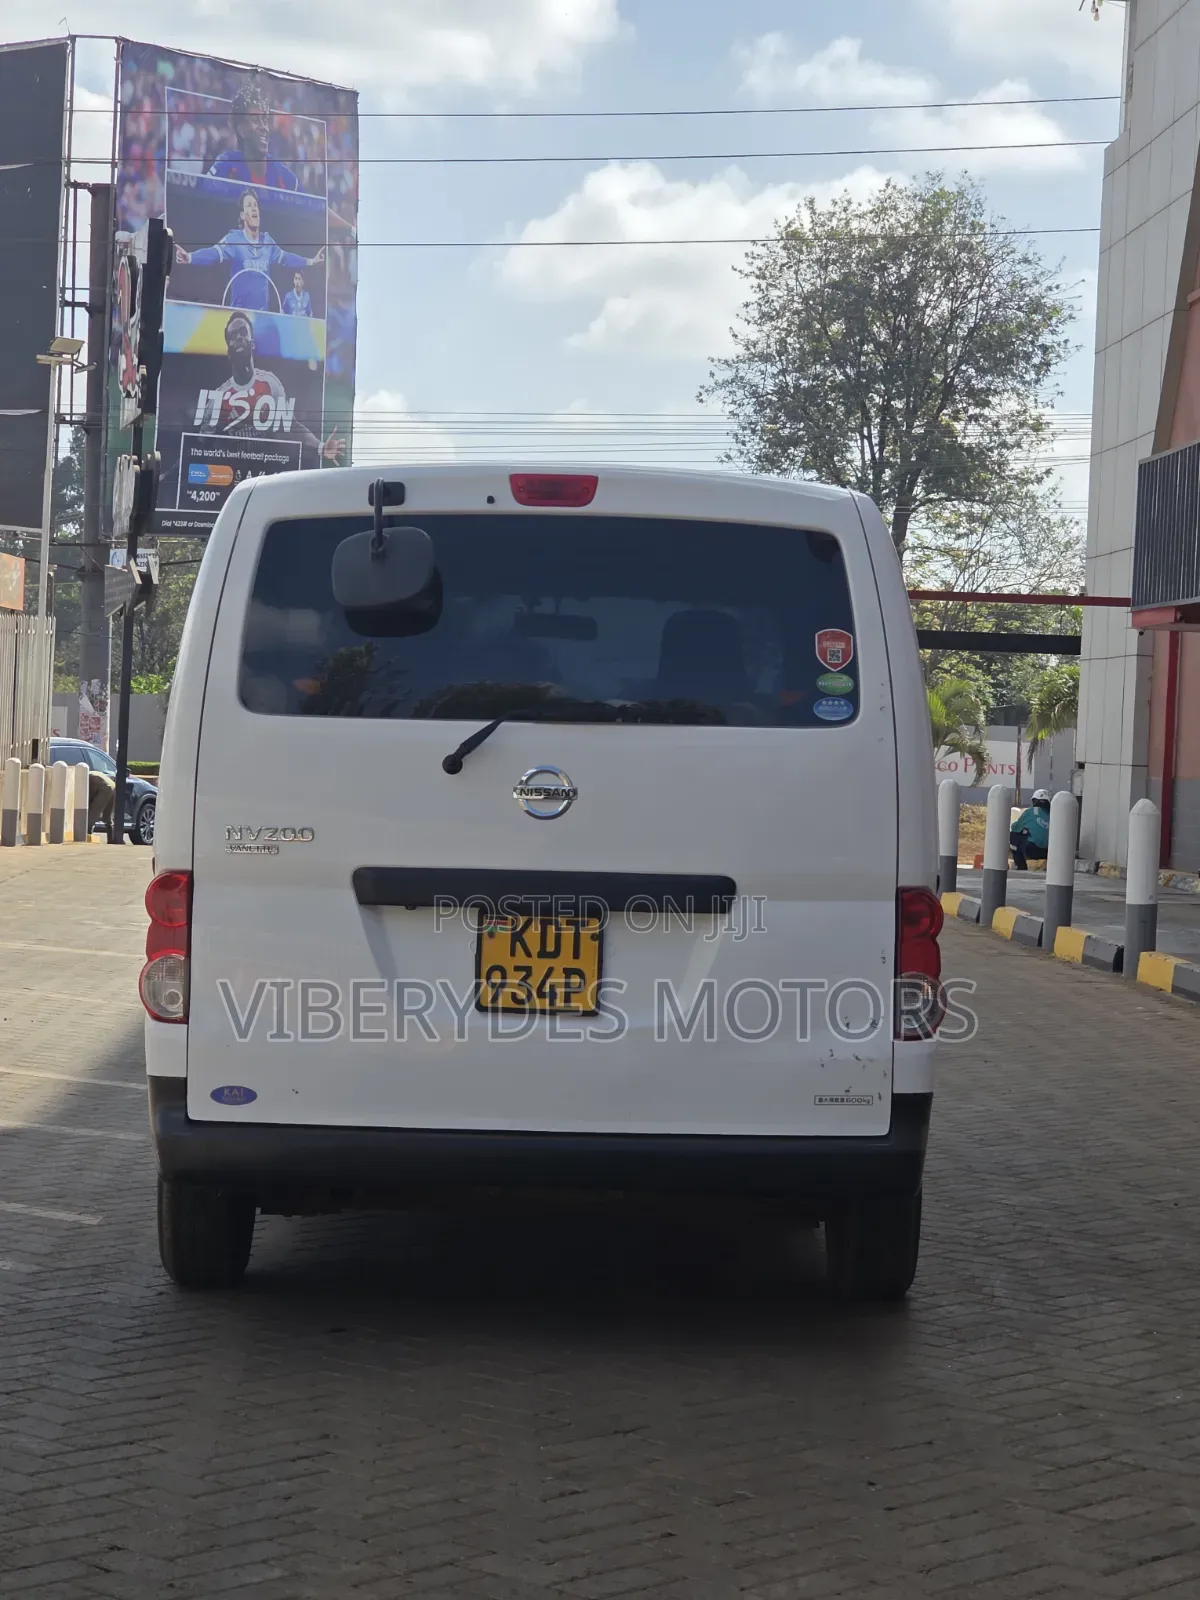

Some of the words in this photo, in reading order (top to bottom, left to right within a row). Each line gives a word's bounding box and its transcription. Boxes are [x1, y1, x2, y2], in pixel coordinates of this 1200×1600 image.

[253, 395, 296, 432] ON
[190, 448, 202, 457] The
[203, 449, 226, 458] world's
[226, 450, 241, 459] best
[241, 452, 264, 461] football
[264, 453, 290, 464] package
[190, 490, 216, 502] 4,200
[936, 760, 959, 772] CO
[963, 757, 1016, 776] PNTS
[519, 788, 572, 797] NISSAN
[225, 825, 315, 842] NV200
[509, 917, 590, 960] KDT
[485, 964, 587, 1008] 934P
